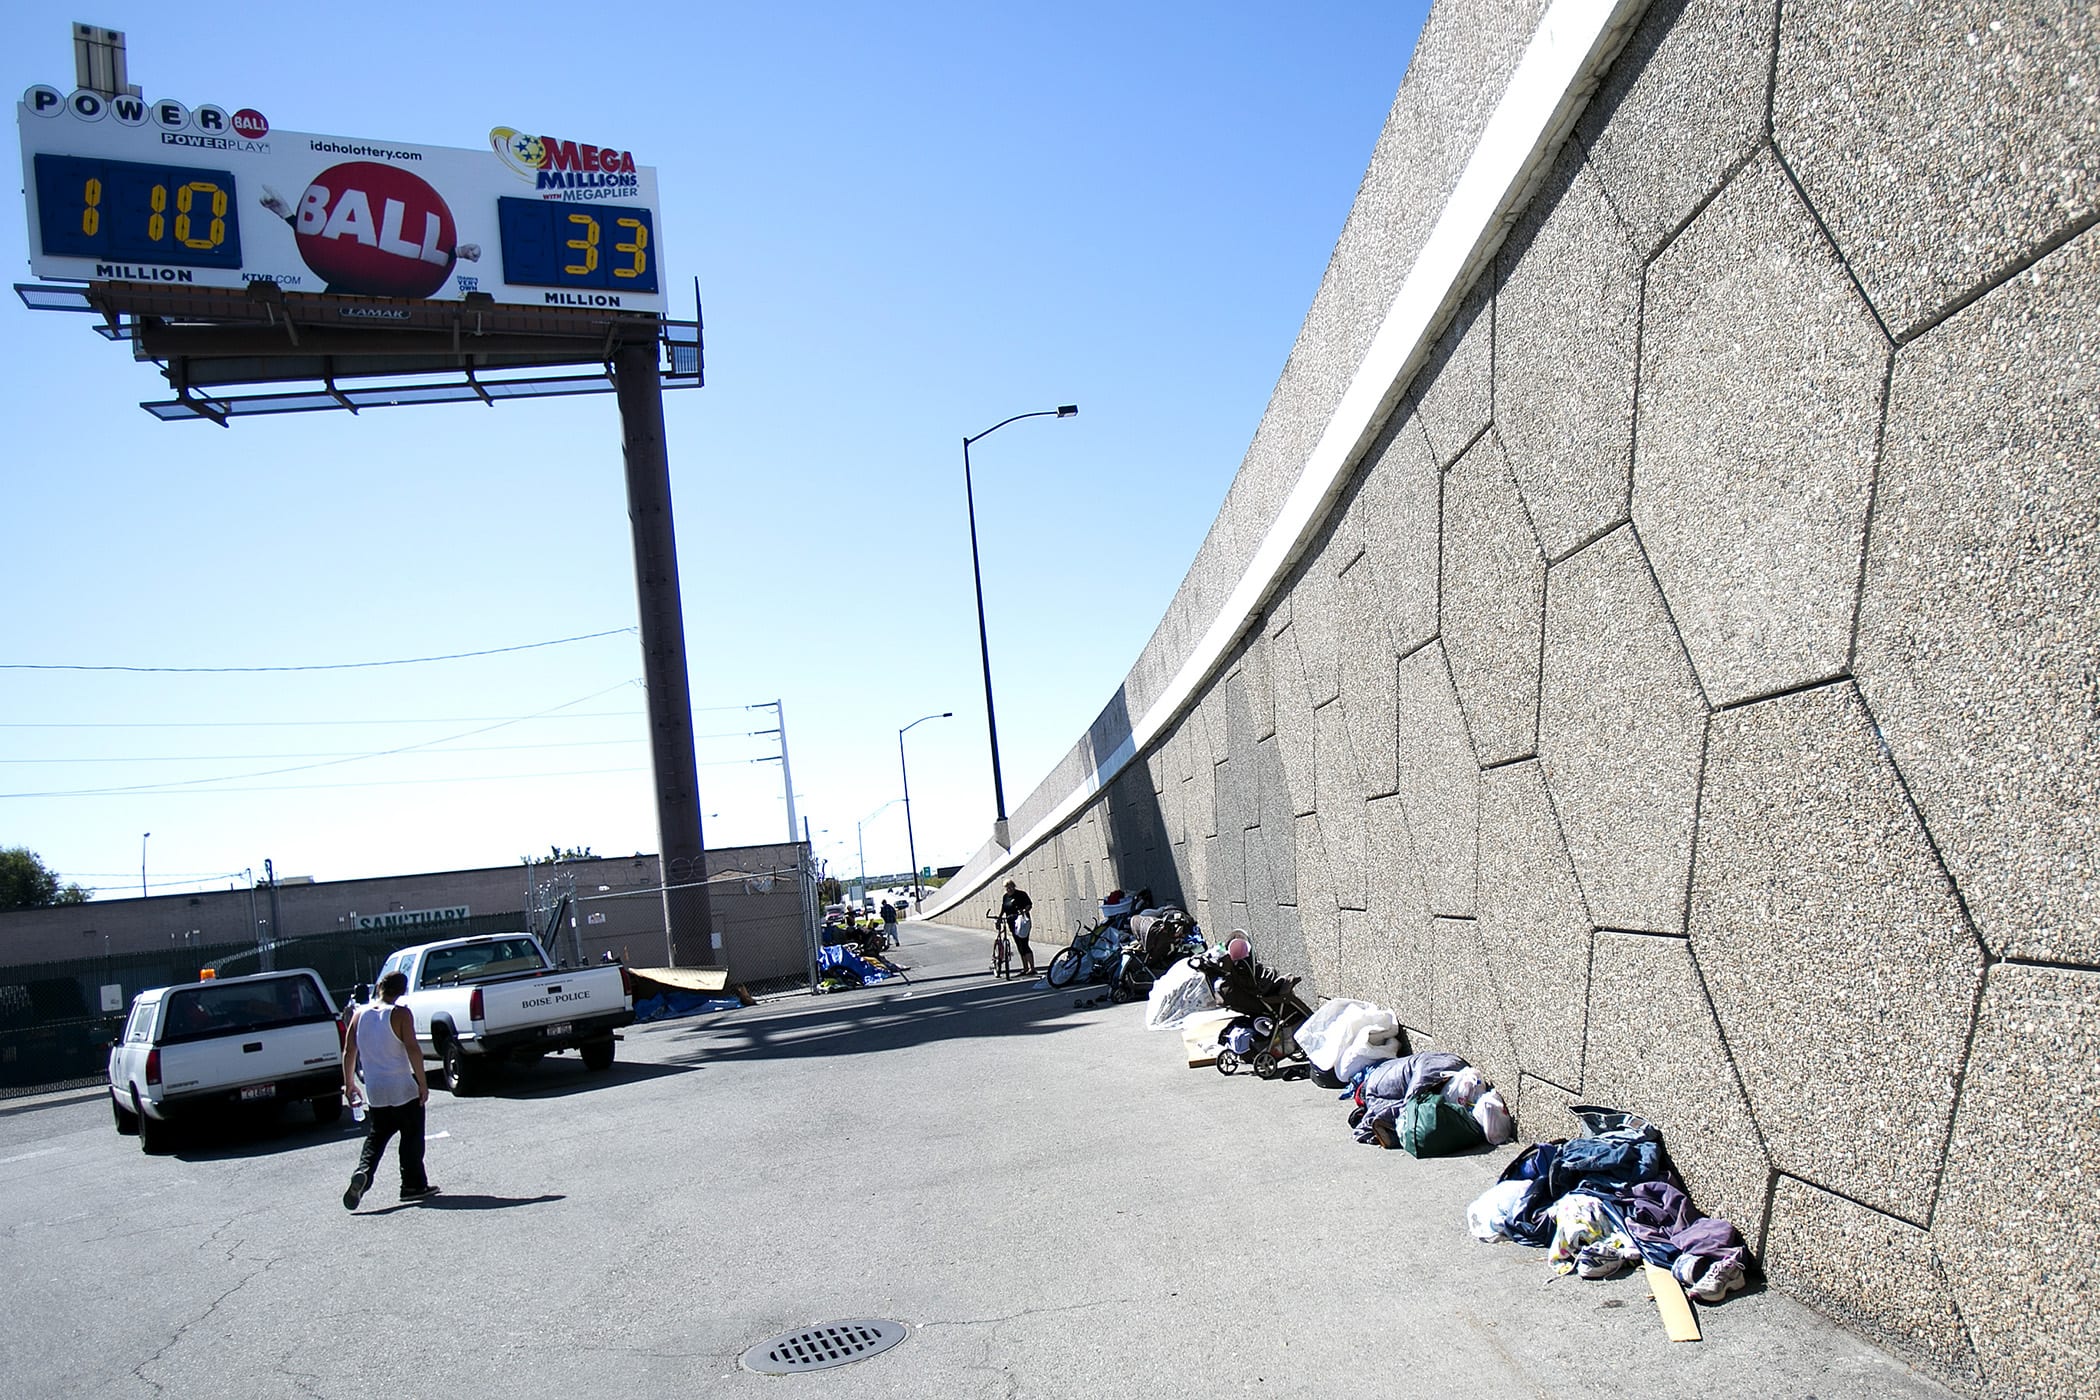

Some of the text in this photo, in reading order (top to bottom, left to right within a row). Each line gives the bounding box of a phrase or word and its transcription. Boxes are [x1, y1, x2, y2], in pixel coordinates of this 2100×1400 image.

[35, 90, 268, 131] POWER BALL
[310, 140, 422, 160] idaholottery.com
[535, 135, 636, 173] MEGA
[536, 171, 637, 189] MILLIONS
[562, 187, 638, 201] MEGAPLIER
[297, 184, 449, 267] BALL
[97, 264, 192, 282] MILLION
[545, 292, 620, 307] MILLION
[360, 908, 467, 934] SANCTUARY
[522, 990, 591, 1009] BOISE POLICE
